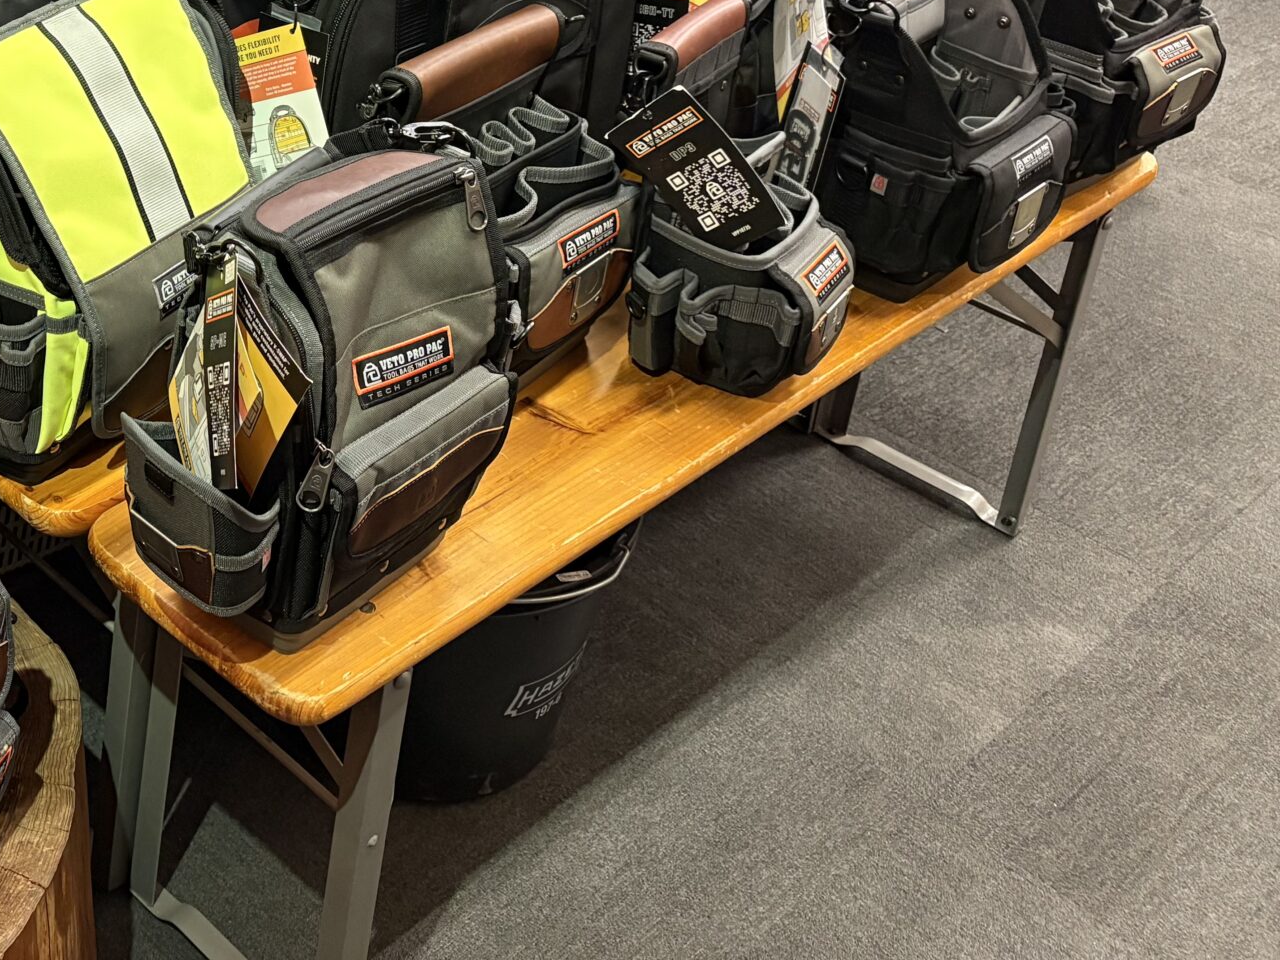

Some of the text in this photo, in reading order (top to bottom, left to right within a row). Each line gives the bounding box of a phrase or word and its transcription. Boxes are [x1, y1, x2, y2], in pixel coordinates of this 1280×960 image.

[245, 52, 257, 61] YOU
[258, 48, 272, 58] NEED
[247, 35, 281, 49] FLEXIBILITY
[662, 118, 678, 135] PRO
[677, 110, 694, 125] PAC
[669, 142, 696, 161] DP3
[574, 231, 591, 246] VETO
[590, 224, 603, 238] PRO
[260, 334, 284, 369] customization
[379, 346, 425, 371] VETO PRO
[383, 353, 444, 380] TOOL BAGS THAT WORK
[368, 364, 448, 400] TECH SERIES
